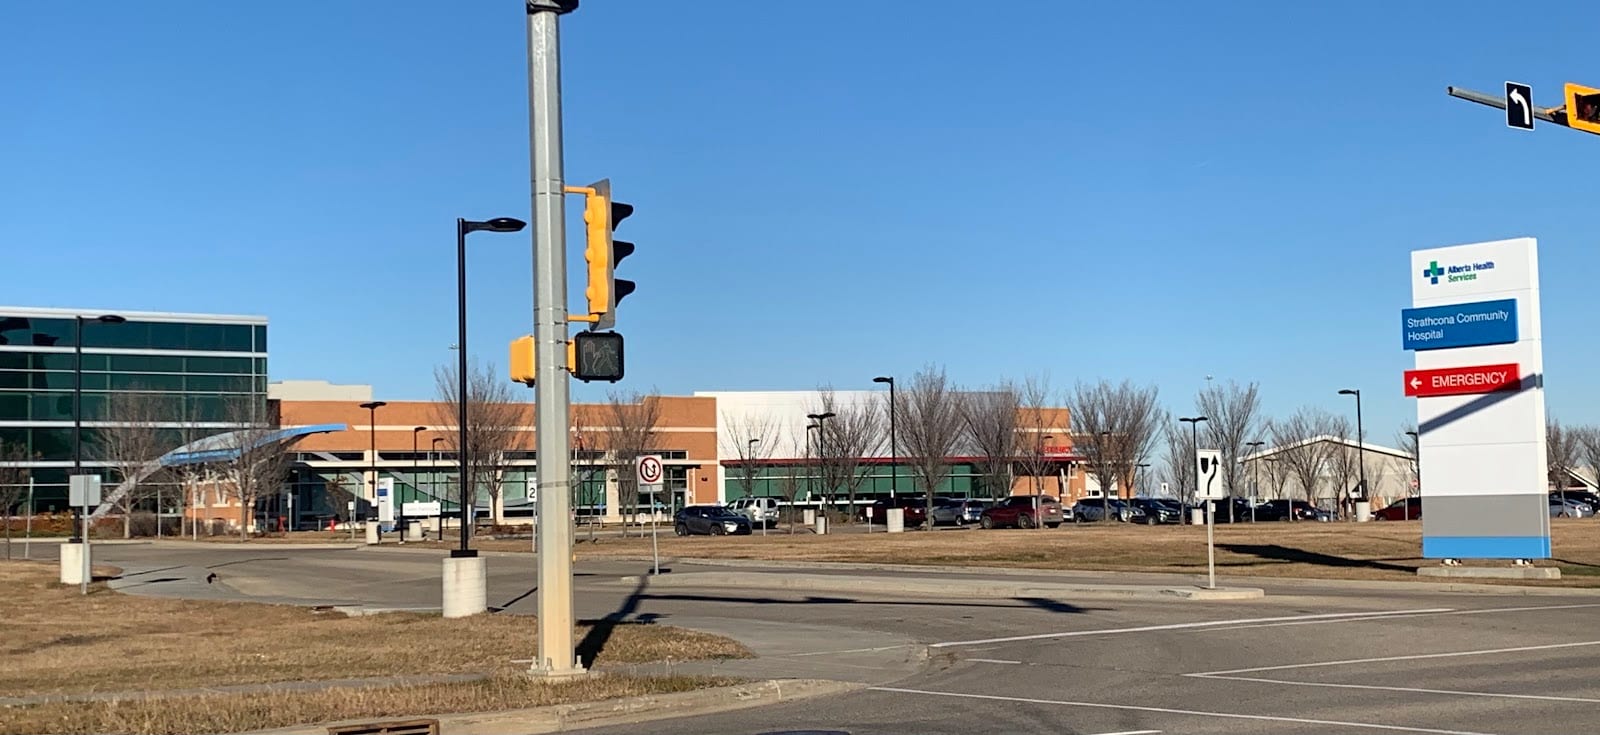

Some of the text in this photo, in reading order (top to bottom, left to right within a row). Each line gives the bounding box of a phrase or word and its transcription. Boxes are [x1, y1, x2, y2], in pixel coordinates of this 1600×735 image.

[1448, 261, 1494, 274] Alberta Health
[1448, 273, 1477, 283] Services
[1407, 310, 1509, 329] Strathcona Community
[1407, 329, 1444, 342] Hospital
[1431, 371, 1508, 388] EMERGENCY
